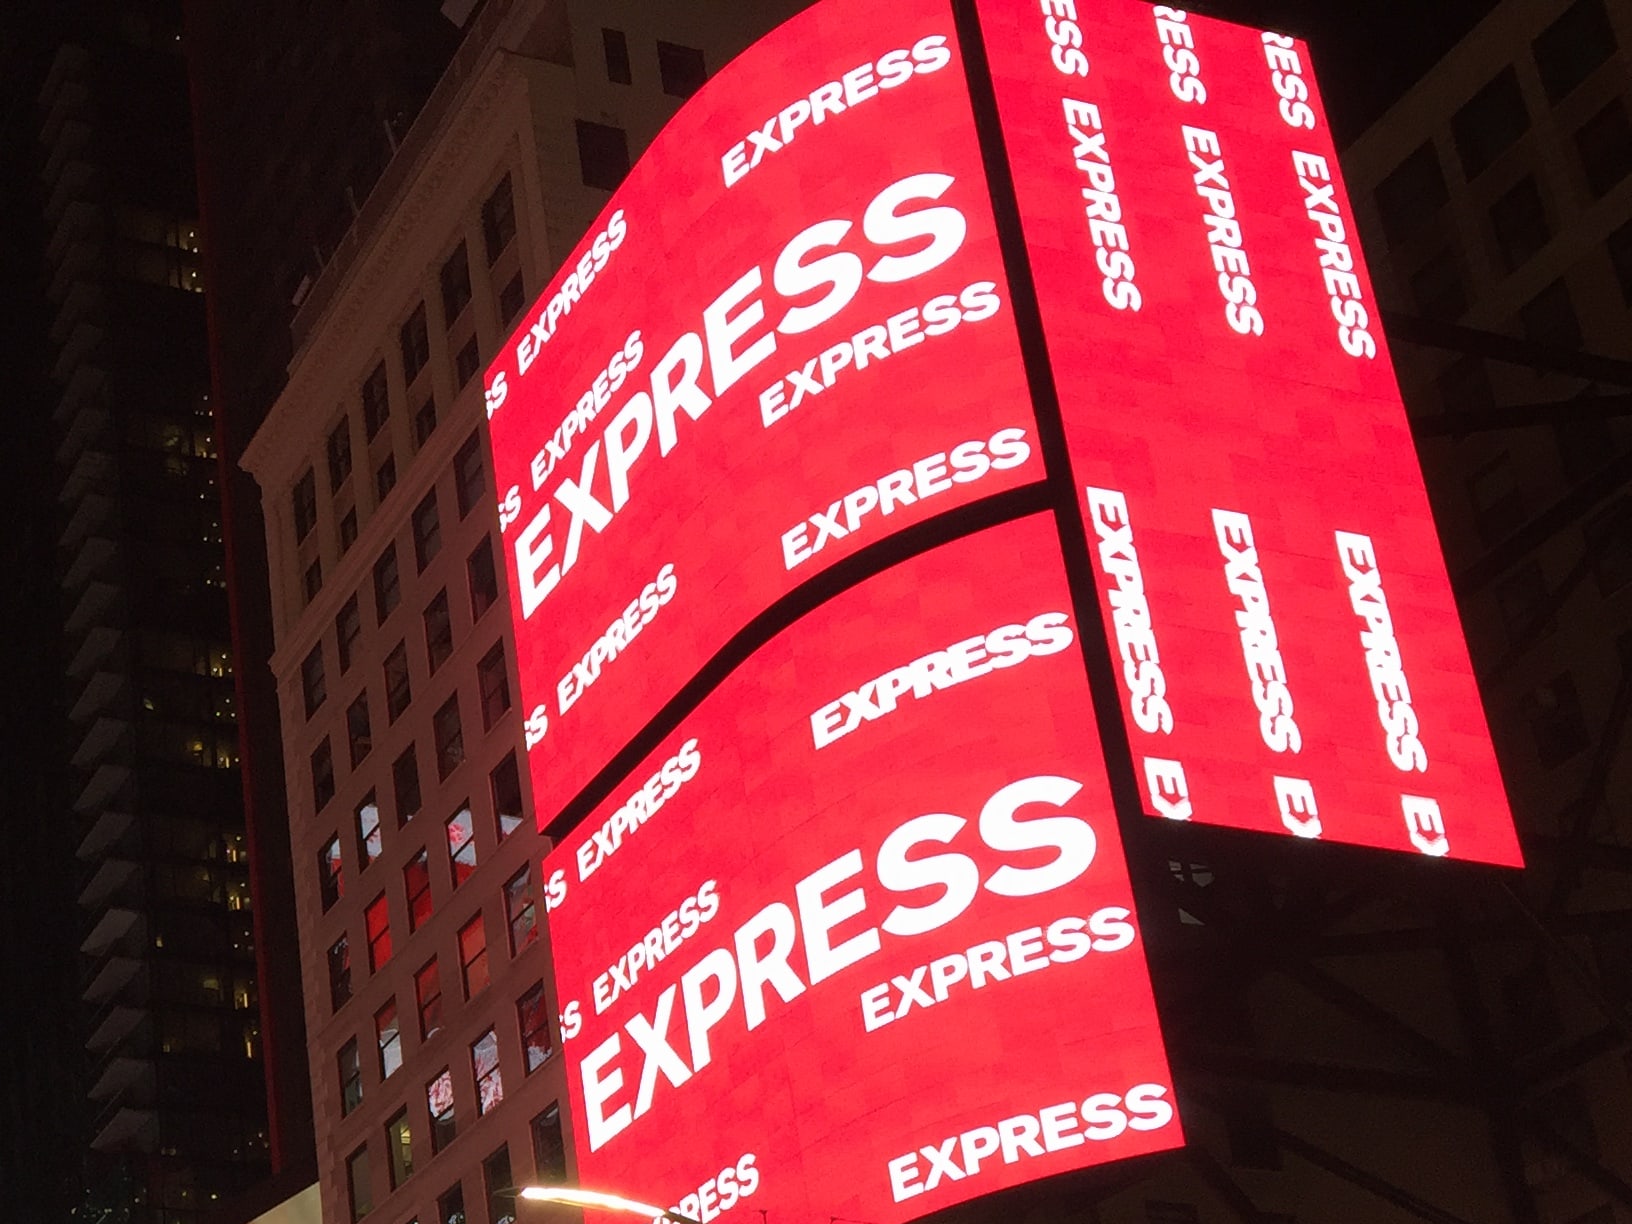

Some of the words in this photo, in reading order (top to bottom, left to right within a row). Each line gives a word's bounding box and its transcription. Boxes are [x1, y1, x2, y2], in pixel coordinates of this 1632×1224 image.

[722, 34, 951, 188] EXPRESS
[1063, 99, 1141, 311] EXPRESS
[1182, 126, 1263, 336] EXPRESS
[1292, 151, 1375, 358] EXPRESS
[516, 209, 627, 376] EXPRESS
[759, 280, 1000, 428] EXPRESS
[514, 172, 967, 620] EXPRESS
[531, 331, 643, 487] EXPRESS
[782, 429, 1030, 570] EXPRESS
[557, 562, 677, 716] EXPRESS
[811, 613, 1073, 749] EXPRESS
[1087, 487, 1173, 734] EXPRESS
[1212, 509, 1301, 753] EXPRESS
[1335, 531, 1427, 772] EXPRESS
[577, 739, 700, 881] EXPRESS
[580, 775, 1097, 1152] EXPRESS
[592, 879, 721, 1016] EXPRESS
[860, 907, 1137, 1032] EXPRESS
[888, 1084, 1172, 1202] EXPRESS
